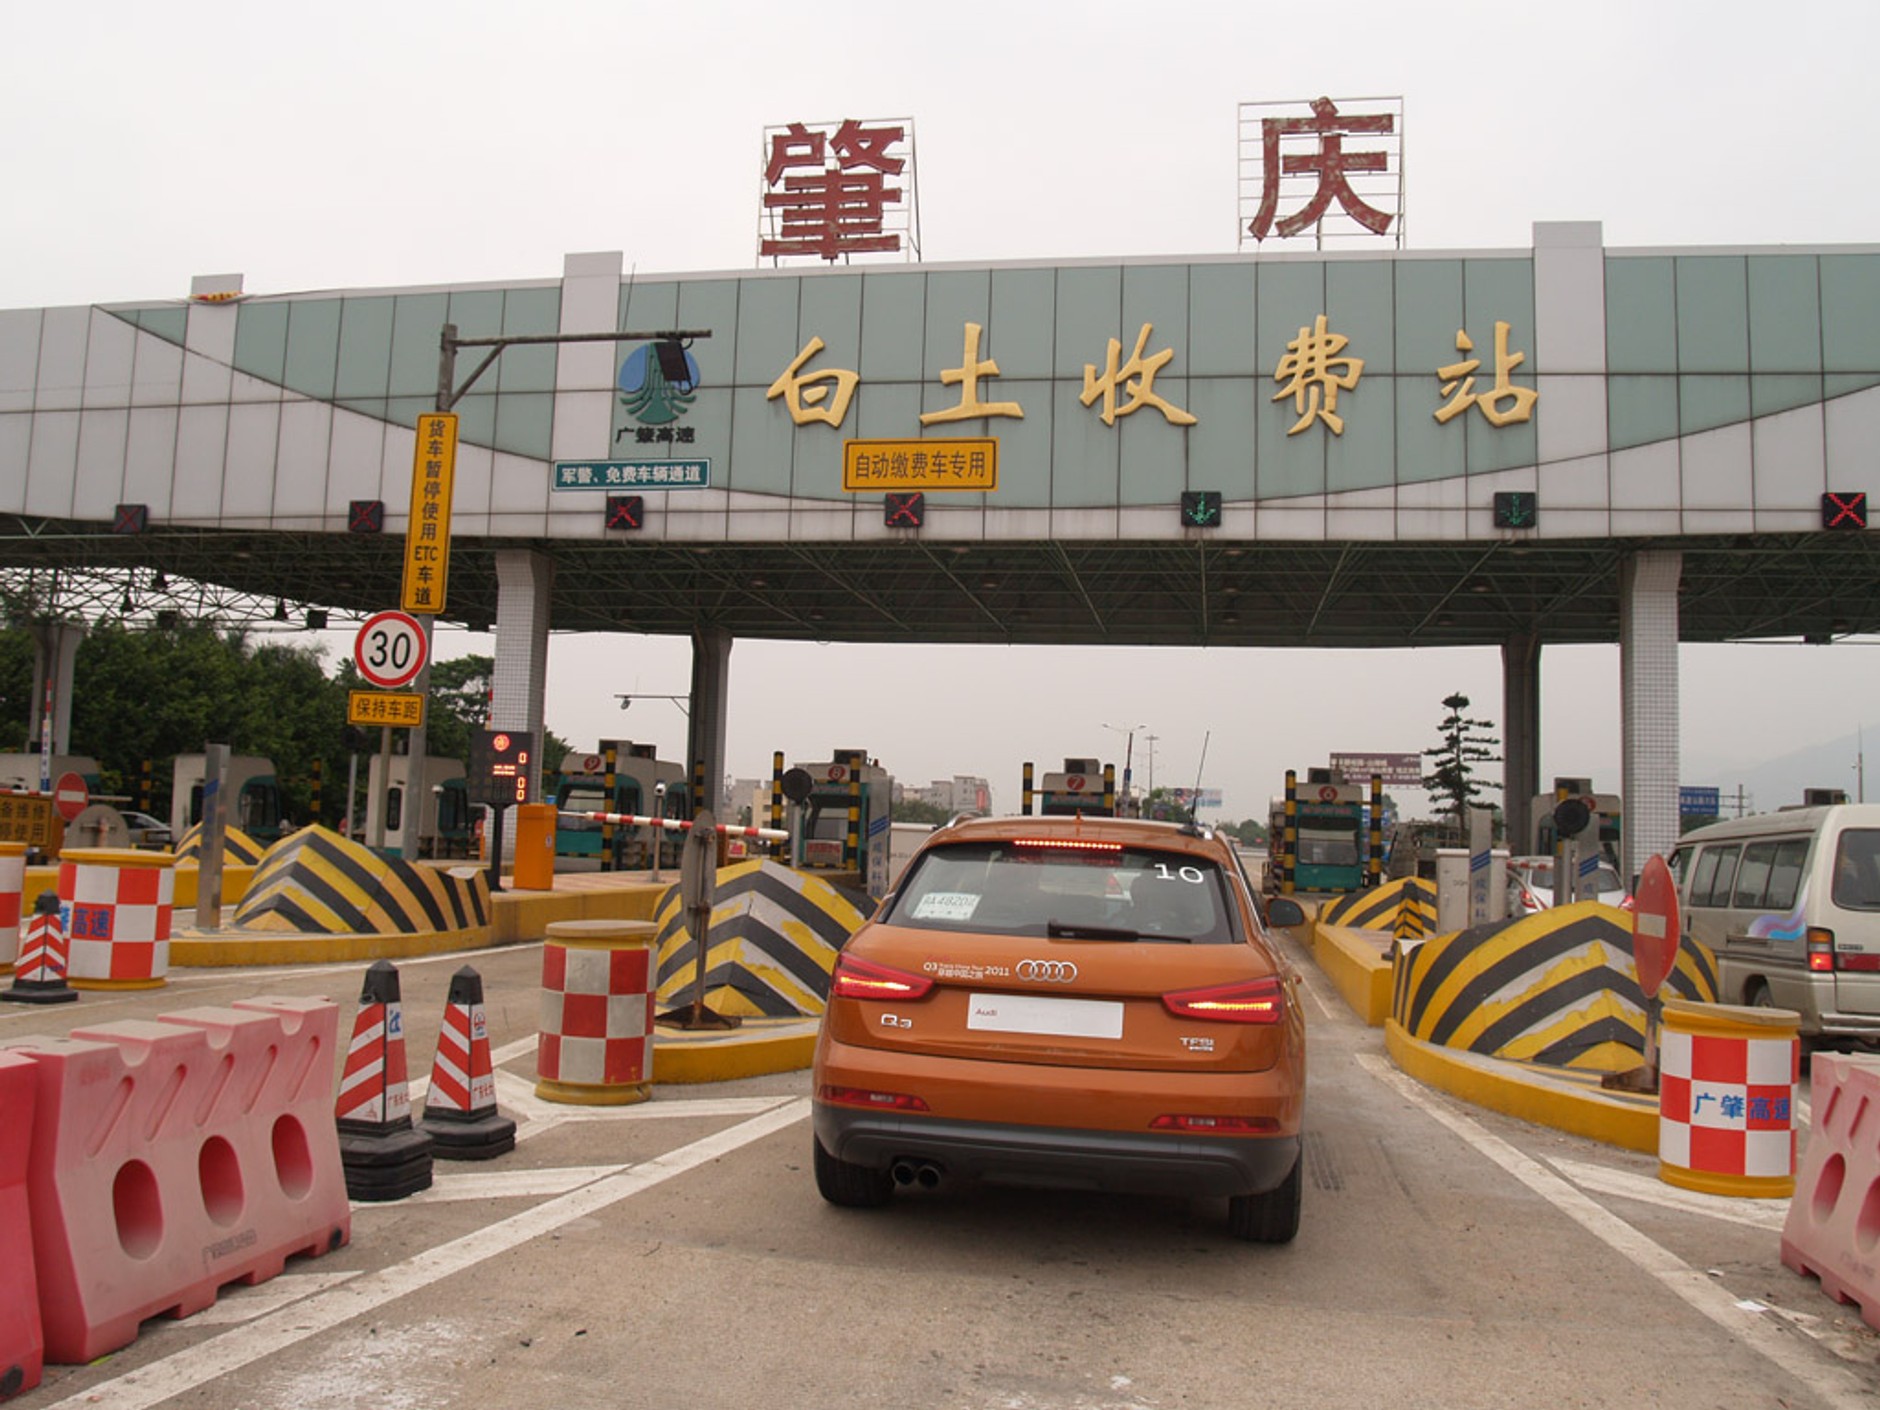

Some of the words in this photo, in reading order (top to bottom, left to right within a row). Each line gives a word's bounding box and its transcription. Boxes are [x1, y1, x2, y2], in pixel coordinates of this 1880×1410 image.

[766, 314, 1539, 437] 白土收费站
[561, 465, 701, 484] 军警、免费车辆通道
[855, 450, 986, 479] 自动缴费车专用
[369, 630, 411, 669] 30
[356, 697, 419, 720] 保持车距
[1154, 863, 1204, 883] 10
[985, 966, 1009, 977] 2011
[881, 1013, 912, 1029] Q3
[975, 1008, 998, 1017] Audi
[1694, 1092, 1791, 1121] 广肇高速
